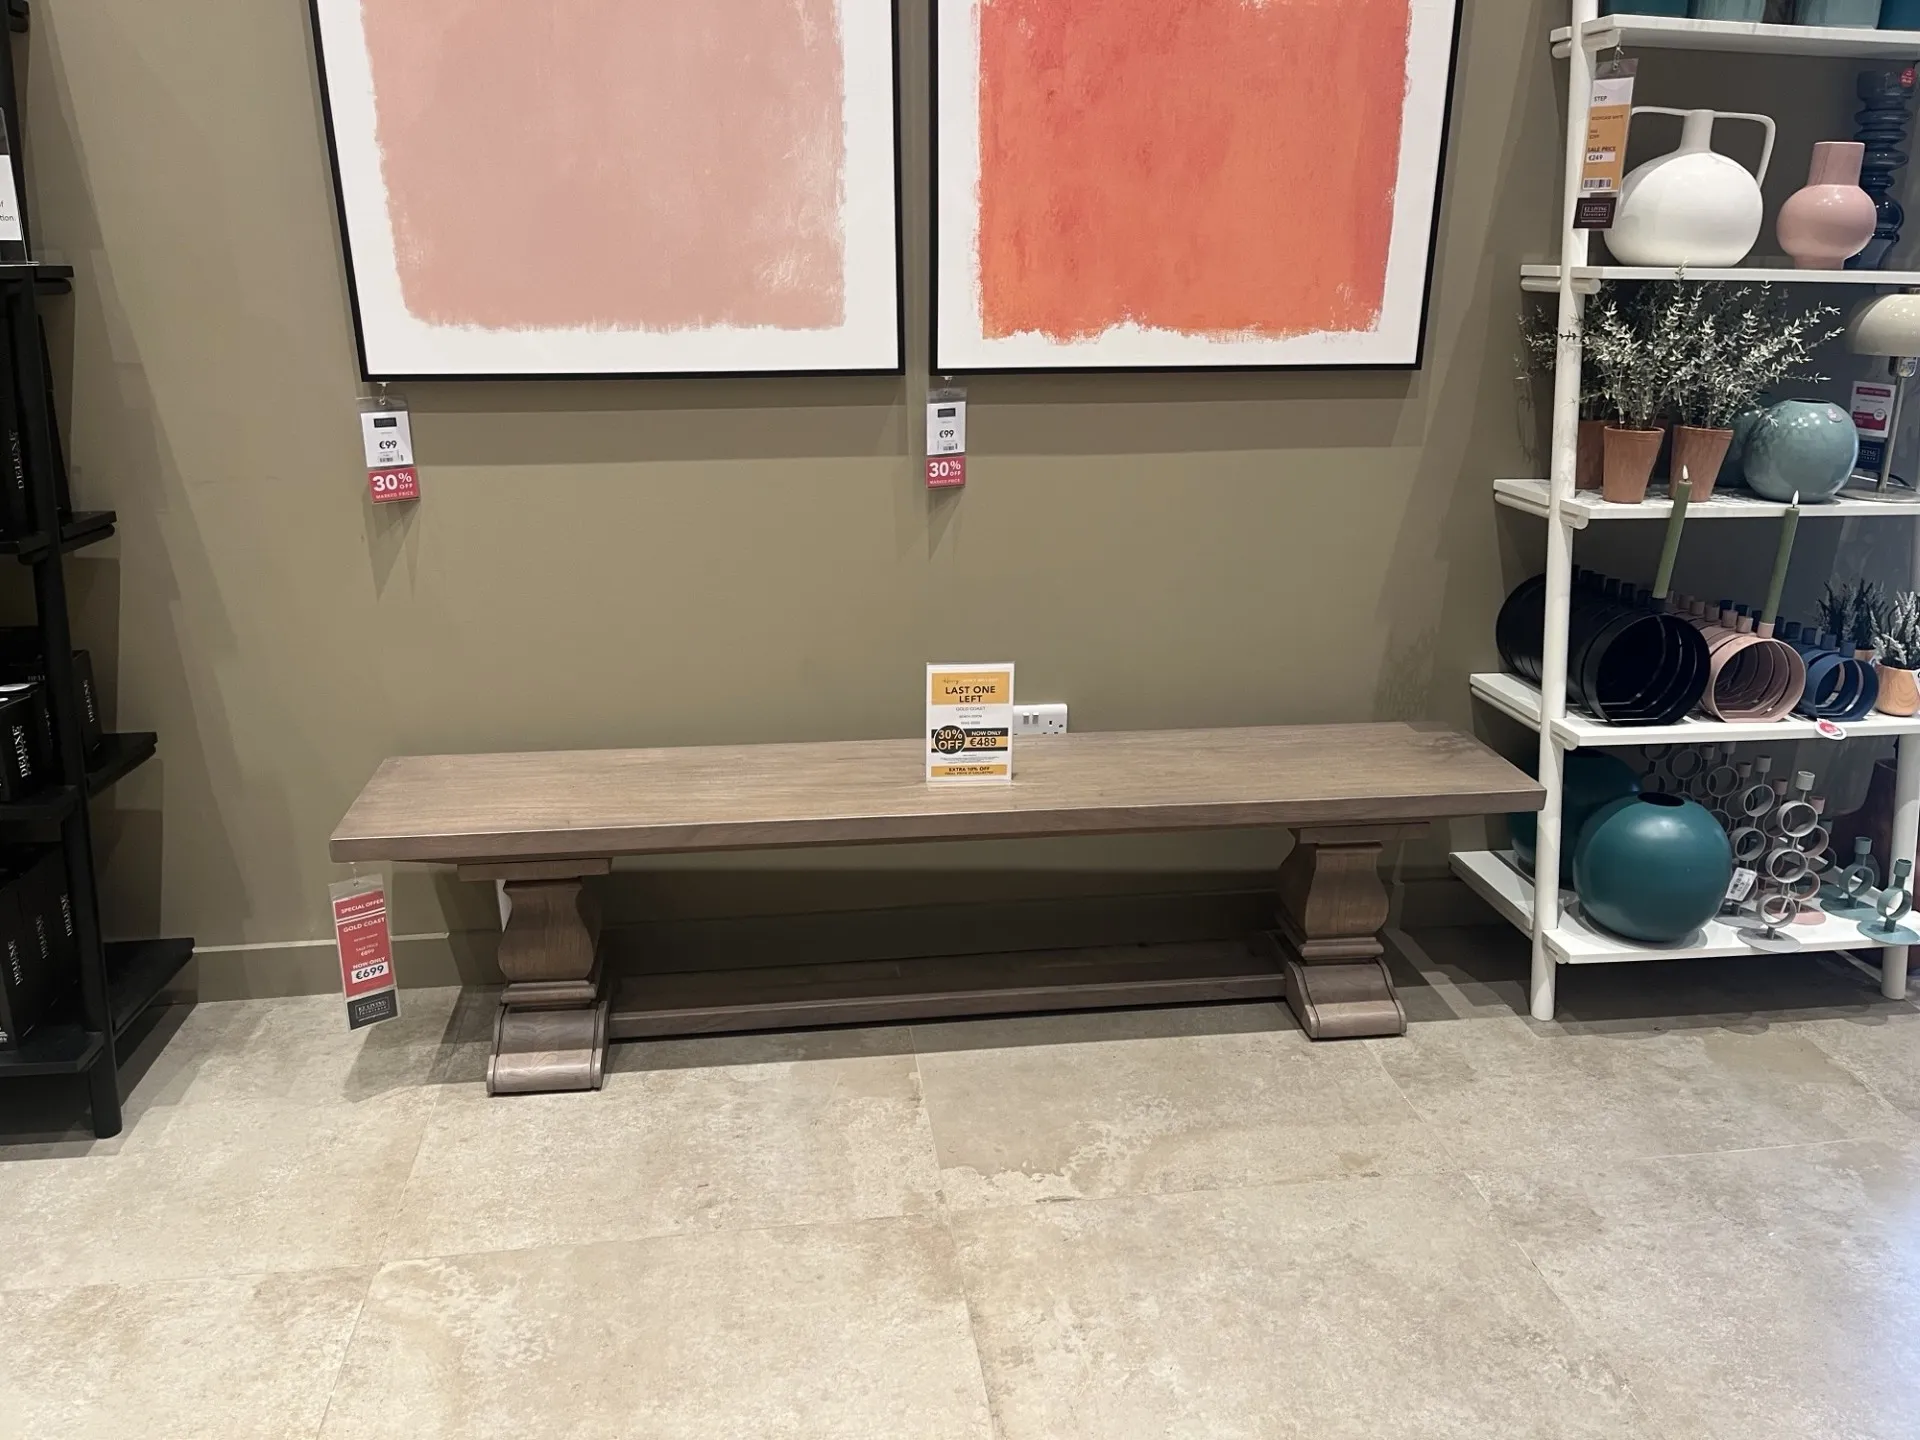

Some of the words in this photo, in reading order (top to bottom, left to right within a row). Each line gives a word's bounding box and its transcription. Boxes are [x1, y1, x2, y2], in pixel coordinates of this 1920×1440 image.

[938, 429, 955, 439] €99
[379, 440, 398, 449] €99
[928, 460, 962, 478] 30%
[372, 472, 412, 492] 30%
[945, 686, 970, 695] LAST
[973, 685, 996, 694] ONE
[959, 695, 983, 703] LEFT
[938, 729, 963, 740] 30%
[938, 740, 963, 750] OFF
[969, 737, 997, 747] €489
[341, 904, 365, 914] SPECIAL
[365, 898, 384, 907] OFFER
[343, 923, 363, 933] GOLD
[363, 917, 385, 927] COAST
[352, 961, 369, 969] NOW
[369, 956, 386, 965] ONLY
[355, 965, 385, 979] €699
